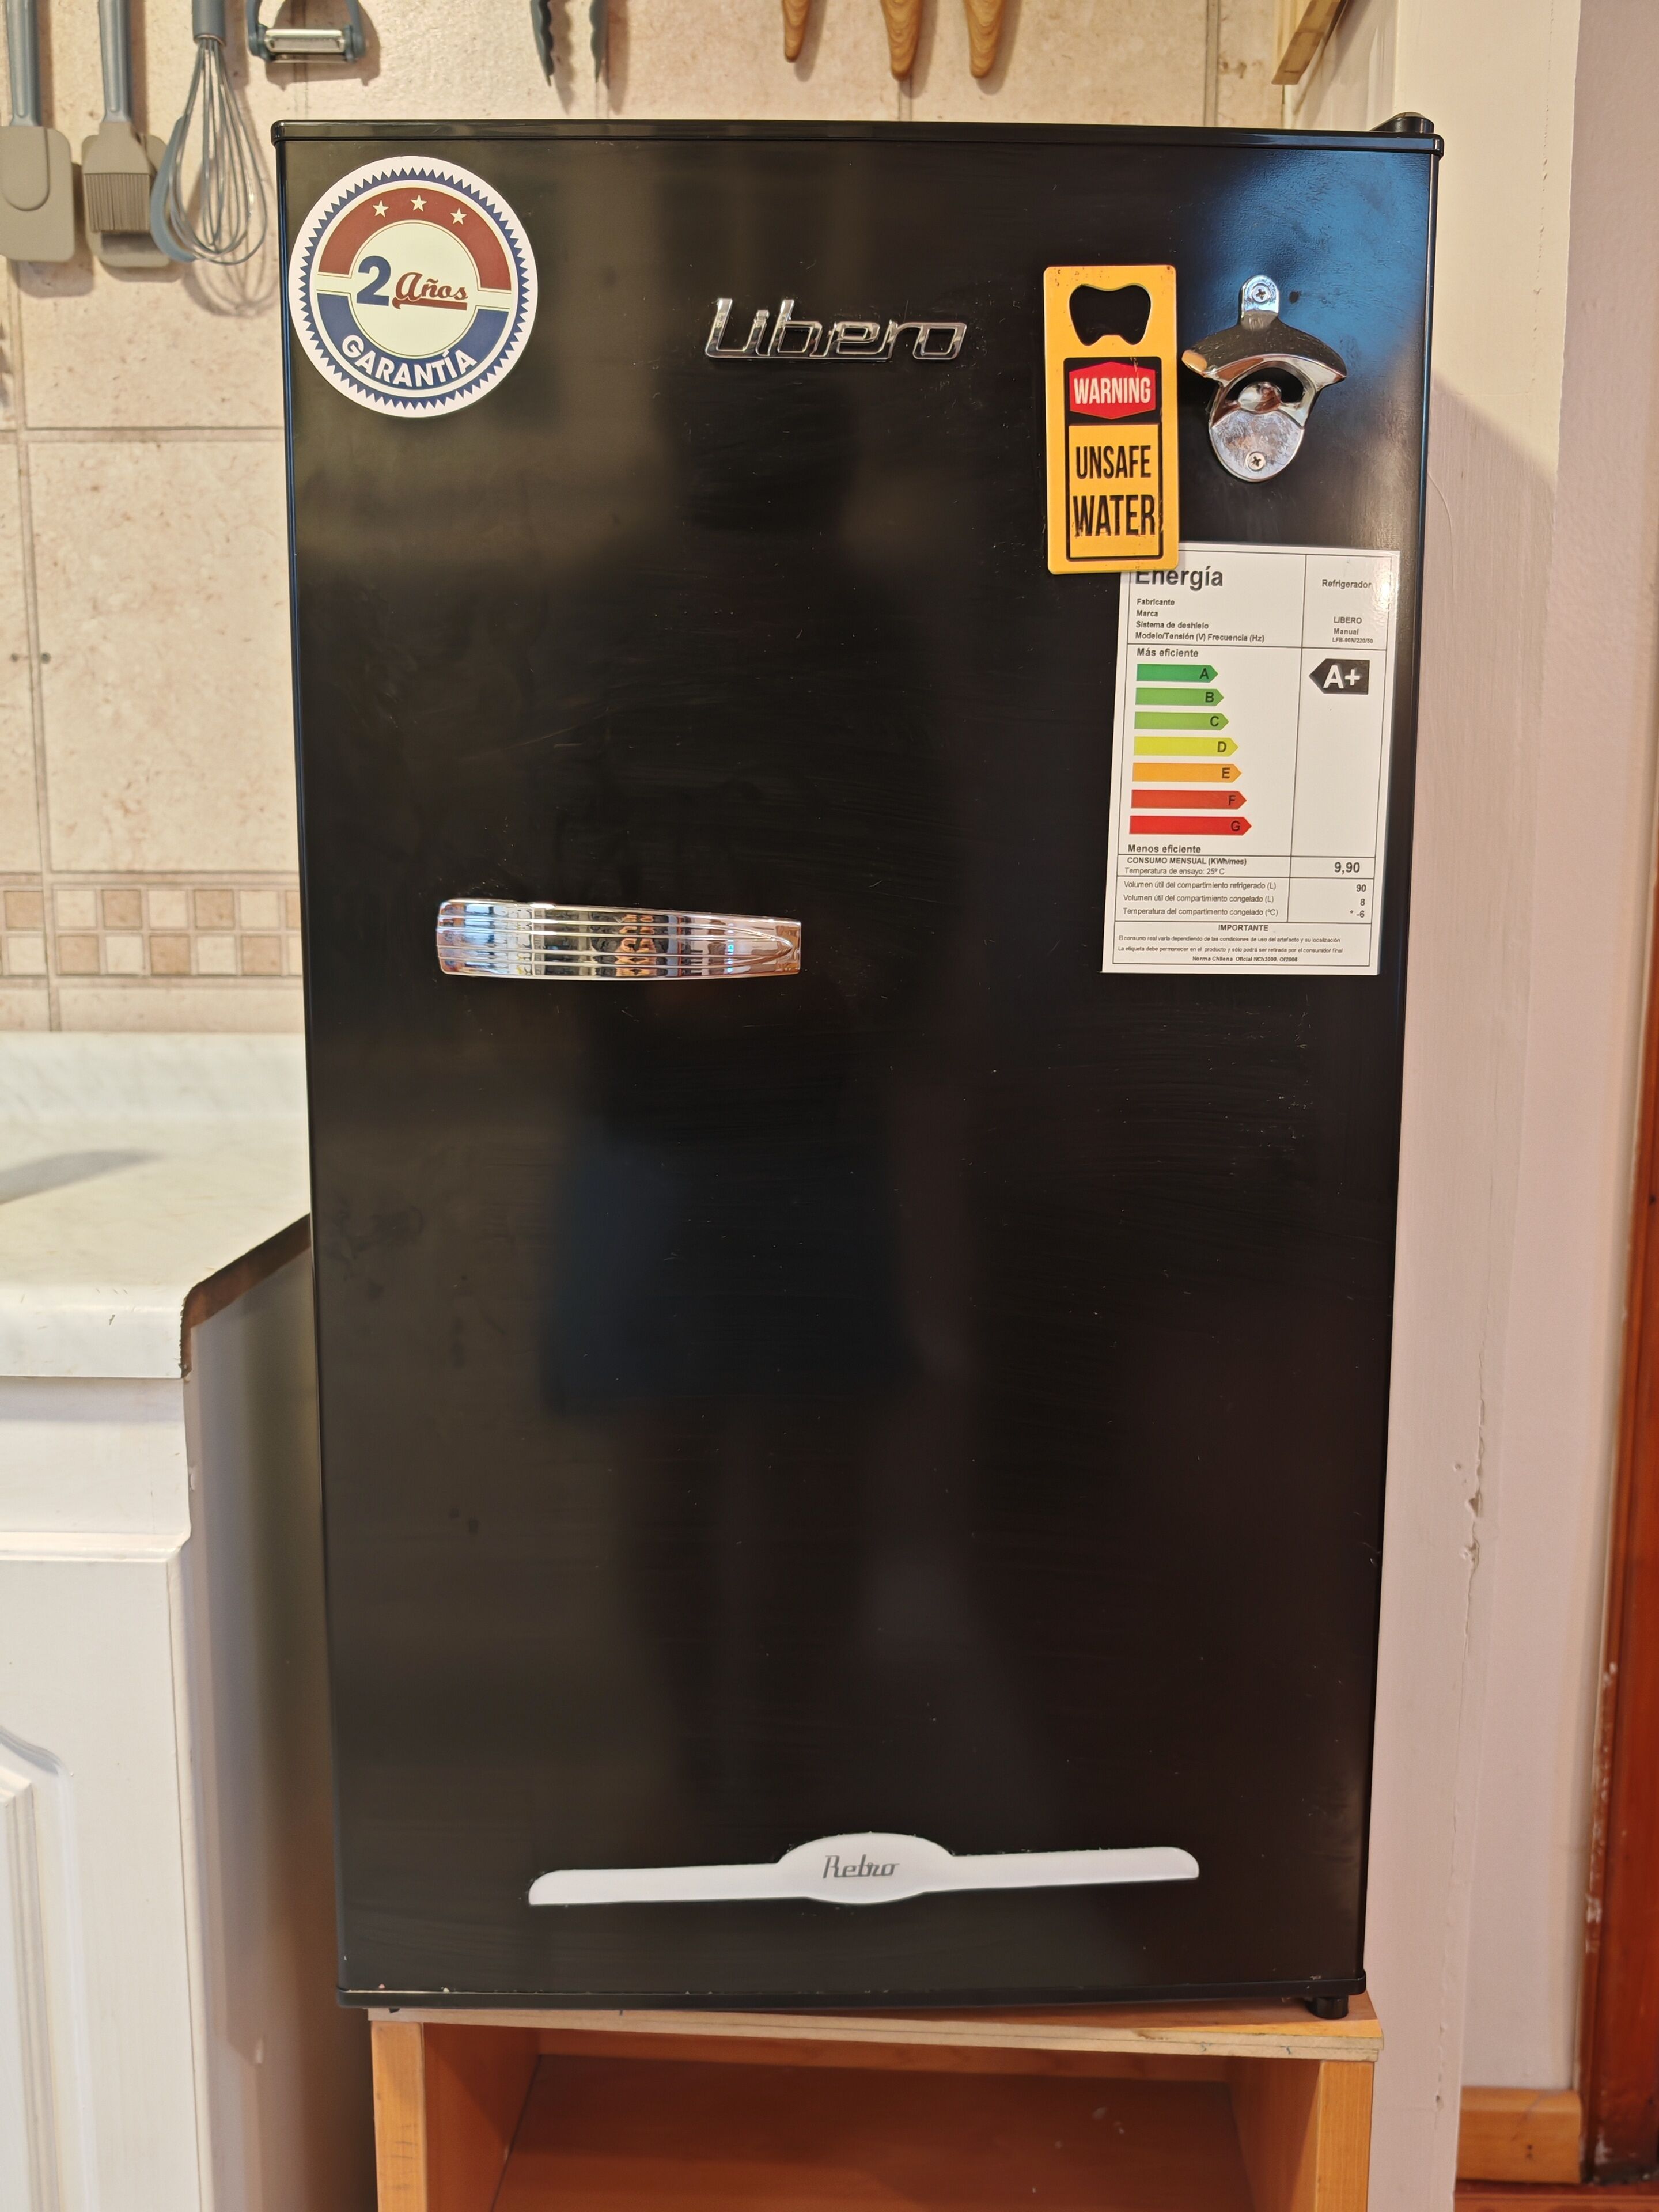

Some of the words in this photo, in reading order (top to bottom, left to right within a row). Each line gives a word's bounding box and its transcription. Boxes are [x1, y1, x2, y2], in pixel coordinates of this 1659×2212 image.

[356, 255, 392, 306] 2
[392, 272, 468, 311] Años
[705, 298, 967, 362] Libero
[342, 335, 477, 387] GARANTÍA
[1073, 378, 1151, 404] WARNING
[1075, 445, 1151, 479] UNSAFE
[1072, 494, 1155, 537] WATER
[1135, 566, 1223, 591] Energía
[1322, 579, 1372, 589] Refrigerador
[1177, 622, 1209, 630] deshielo
[1135, 632, 1194, 641] Modelo/Tensión
[1196, 633, 1206, 642] (V)
[1249, 635, 1265, 643] (Hz)
[1137, 647, 1156, 656] Más
[1159, 649, 1199, 657] eficiente
[1199, 668, 1209, 679] A
[1323, 665, 1361, 689] A+
[1205, 692, 1214, 703] B
[1210, 716, 1219, 726] C
[1217, 741, 1226, 752] D
[1221, 767, 1230, 778] E
[1228, 795, 1236, 805] F
[1230, 820, 1241, 832] G
[1127, 844, 1159, 853] Menos
[1162, 845, 1201, 853] eficiente
[1125, 867, 1166, 875] Temperatura
[1334, 862, 1360, 874] 9,90
[1177, 881, 1228, 891] compartimiento
[1230, 882, 1265, 891] refrigerado
[1356, 884, 1366, 892] 90
[1176, 895, 1228, 904] compartimiento
[1229, 896, 1263, 904] congelado
[1360, 898, 1365, 906] 8
[1123, 908, 1165, 916] Temperatura
[1229, 909, 1263, 917] congelado
[823, 1854, 900, 1878] Retro
